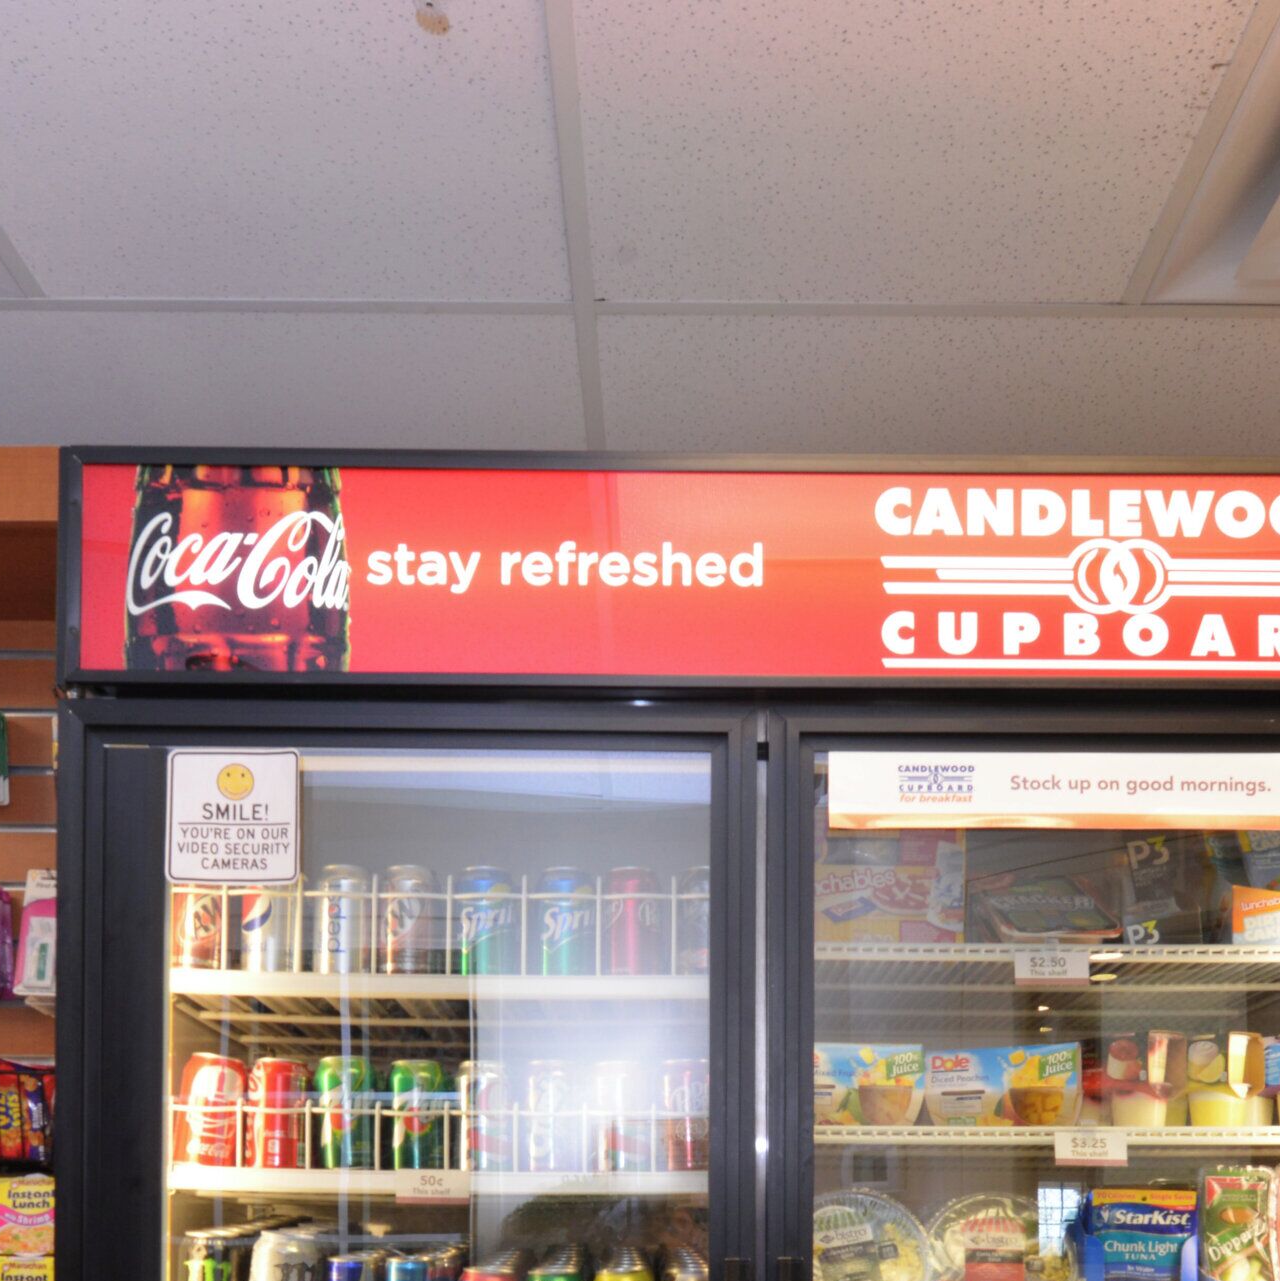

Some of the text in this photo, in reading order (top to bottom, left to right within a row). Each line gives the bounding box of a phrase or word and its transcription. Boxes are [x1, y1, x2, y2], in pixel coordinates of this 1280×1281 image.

[127, 510, 351, 615] Coca-Cola
[366, 542, 765, 593] stay refreshed
[898, 765, 974, 774] CANDLEWOOD
[898, 783, 974, 793] CUPBOARD
[1011, 775, 1271, 798] Stock up on good mornings.
[202, 802, 269, 822] SMILE!
[180, 828, 288, 840] YOU'RE ON OUR
[177, 843, 290, 856] VIDEO SECURITY
[1127, 837, 1169, 869] P3
[201, 857, 267, 871] CAMERAS
[1127, 920, 1160, 944] P3
[1030, 957, 1066, 969] $2.50
[890, 1062, 919, 1077] Juice
[931, 1056, 970, 1071] Dole
[1043, 1061, 1073, 1077] Juice
[931, 1074, 990, 1083] Diced Peaches
[1071, 1137, 1107, 1149] $3.25
[420, 1175, 444, 1187] 50¢
[8, 1190, 55, 1199] Instant
[13, 1199, 50, 1209] Lunch
[1114, 1210, 1190, 1227] StarKist
[1104, 1240, 1178, 1254] Chunk Light
[1208, 1223, 1268, 1262] Dipperz
[1125, 1253, 1156, 1261] TUNA
